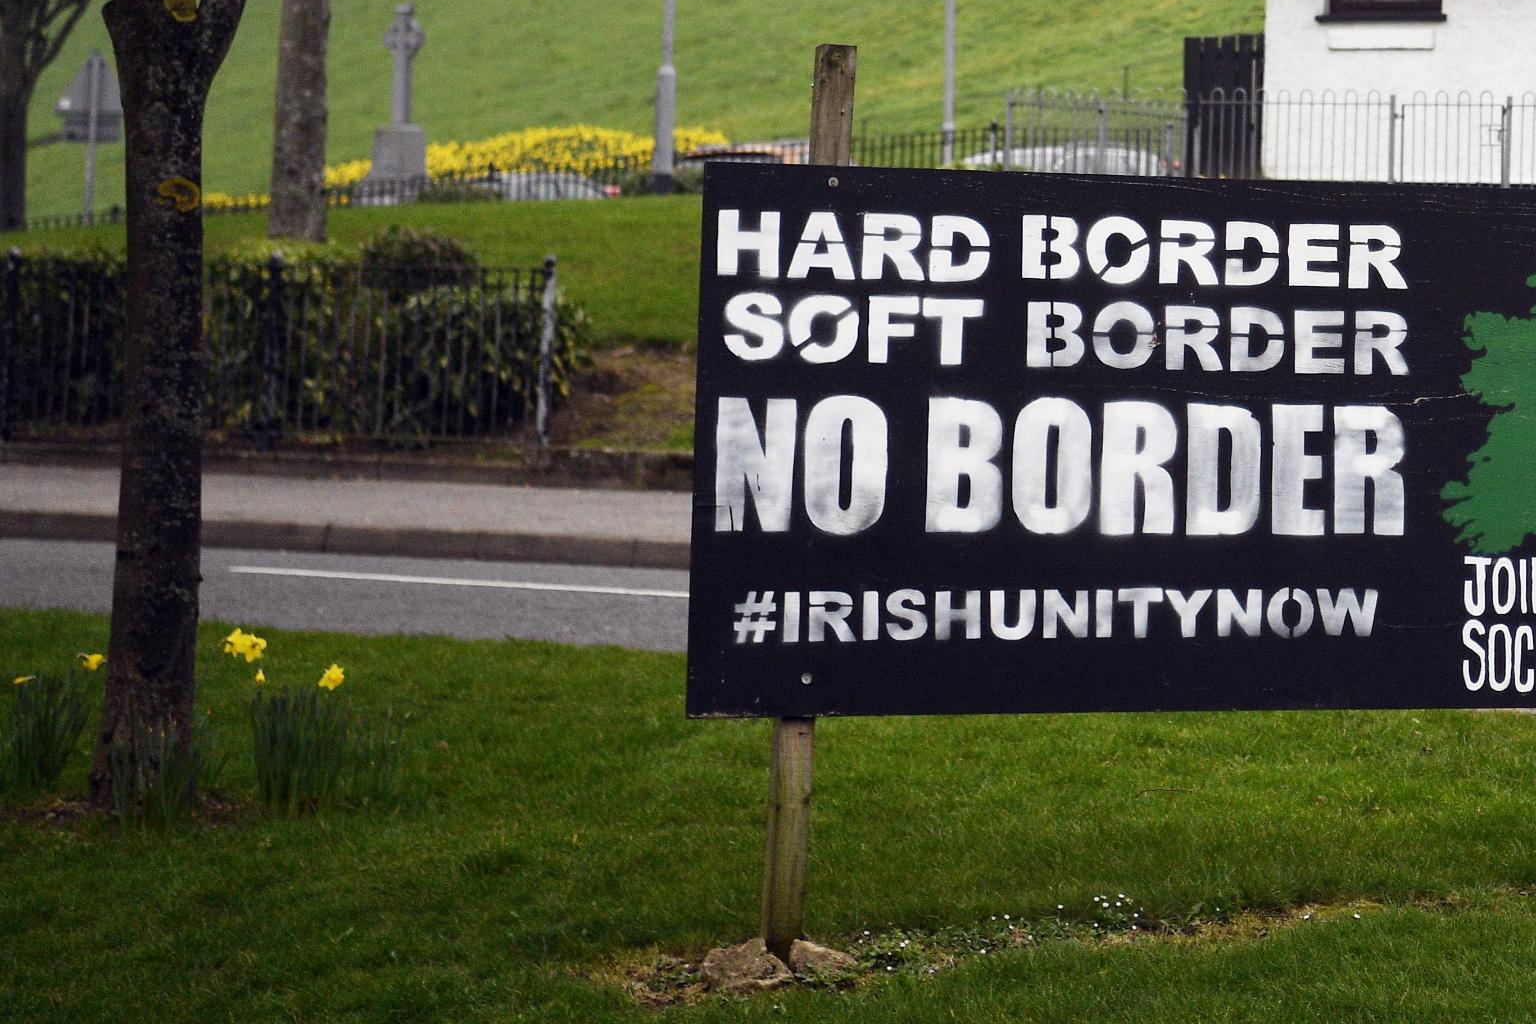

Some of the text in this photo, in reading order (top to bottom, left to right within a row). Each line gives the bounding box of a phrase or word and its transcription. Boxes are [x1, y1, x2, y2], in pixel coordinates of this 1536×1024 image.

[717, 209, 1408, 289] HARD BORDER
[724, 292, 1408, 375] SOFT BORDER
[715, 395, 1404, 536] NO BORDER
[734, 587, 1378, 643] #IRISHUNITYNOW
